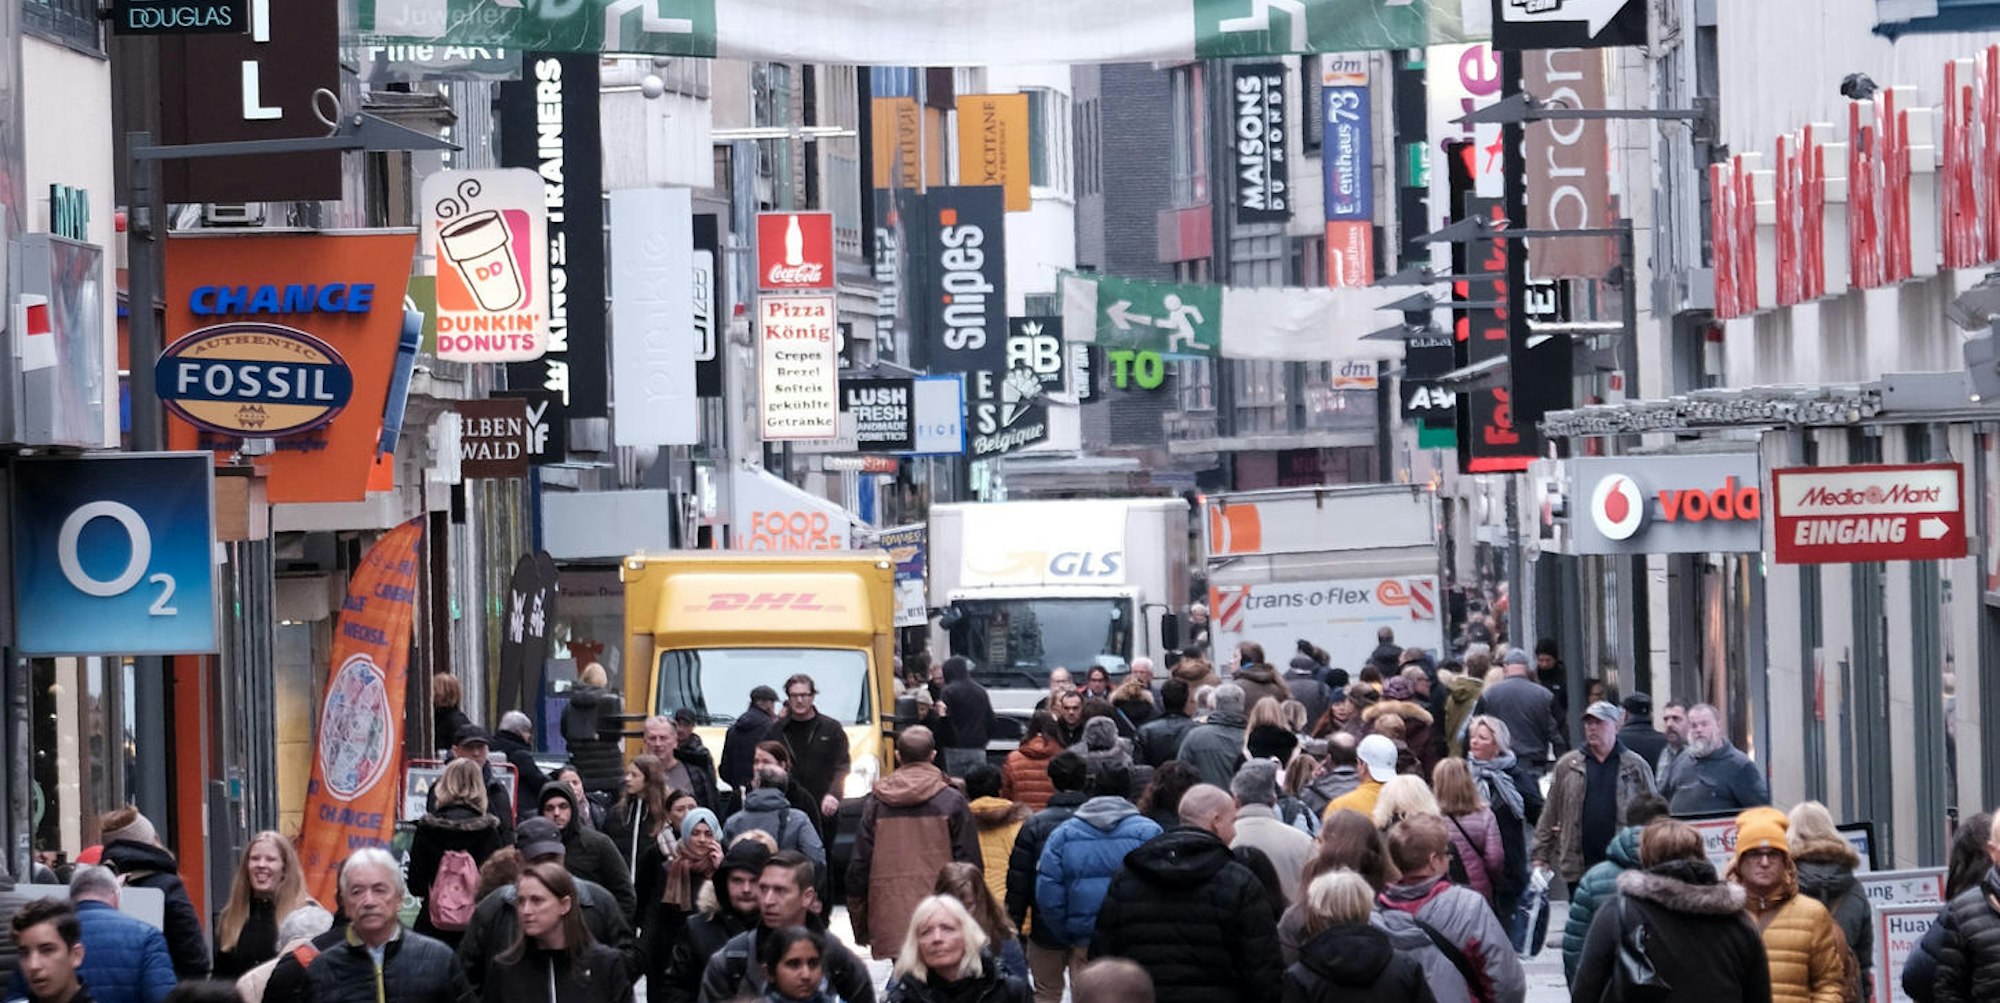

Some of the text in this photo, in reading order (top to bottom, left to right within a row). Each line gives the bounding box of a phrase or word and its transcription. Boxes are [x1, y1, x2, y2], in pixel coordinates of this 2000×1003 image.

[129, 6, 232, 28] DOUGLAS
[1332, 56, 1362, 73] dm
[1328, 90, 1361, 123] 73
[536, 58, 564, 223] TRAINERS
[1236, 75, 1265, 210] MAISONS
[1268, 75, 1285, 211] DU MONDE
[475, 262, 503, 282] DD
[939, 224, 994, 350] snipes
[188, 283, 375, 316] CHANGE
[769, 303, 826, 318] Pizza
[437, 313, 540, 331] DUNKIN'
[766, 324, 831, 342] König
[194, 335, 317, 360] AUTHENTIC
[437, 334, 535, 352] DONUTS
[775, 351, 822, 366] Crepes
[1109, 350, 1165, 390] TO
[1340, 361, 1370, 378] dm
[178, 363, 334, 401] FOSSIL
[777, 367, 820, 377] Brezel
[848, 387, 908, 406] LUSH
[858, 421, 908, 431] ANDMADE
[858, 431, 908, 441] OSMETICS
[460, 440, 521, 461] WALD
[973, 424, 1046, 454] Belgique
[1657, 475, 1760, 522] voda
[1797, 484, 1942, 507] Media Markt
[752, 511, 829, 535] FOOD
[1794, 517, 1908, 546] EINGANG
[58, 500, 177, 616] O2
[1049, 551, 1123, 577] GLS
[706, 593, 824, 612] DHL
